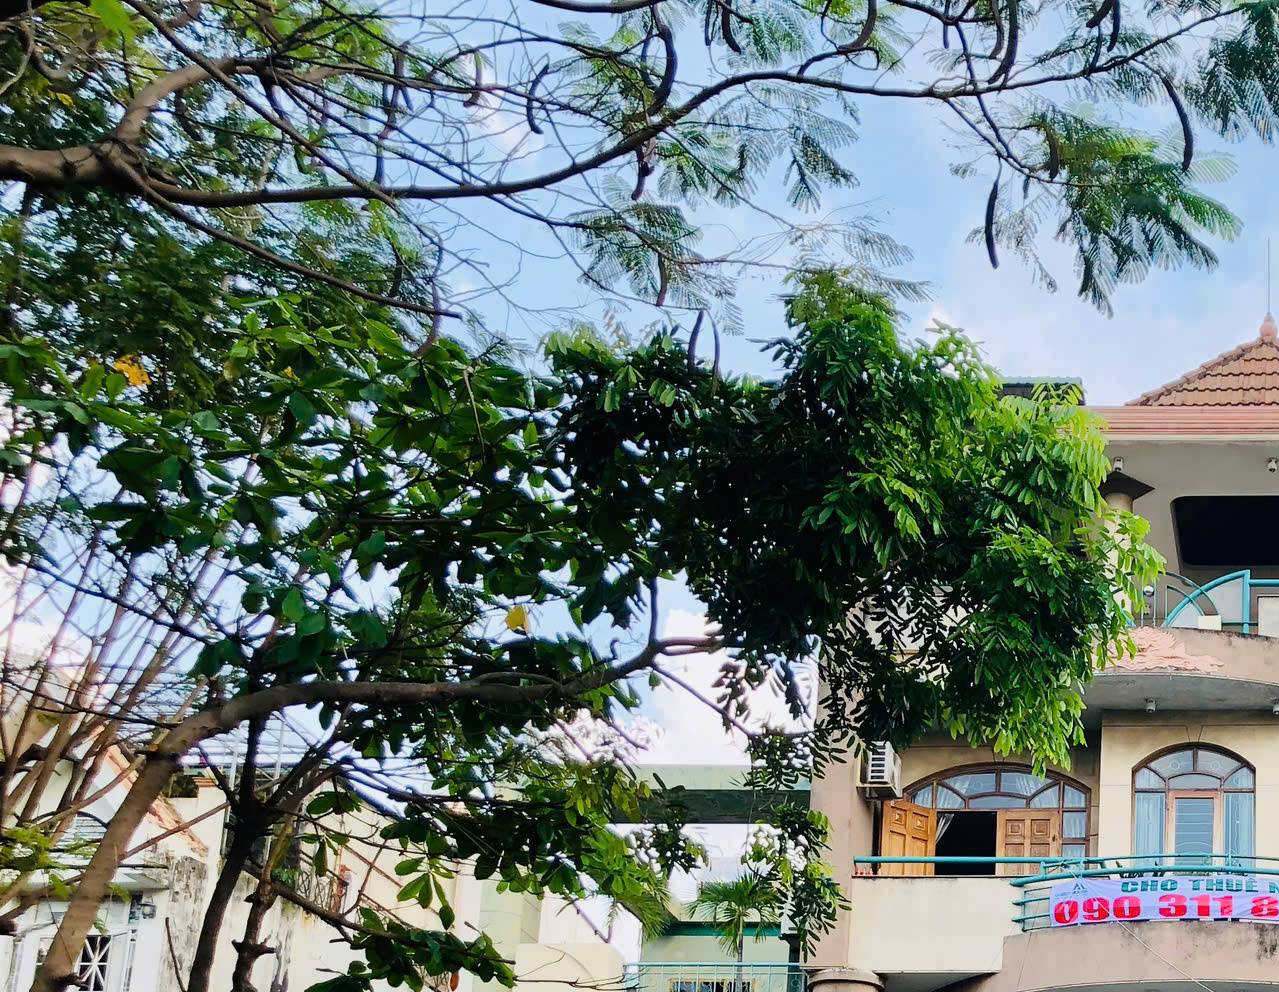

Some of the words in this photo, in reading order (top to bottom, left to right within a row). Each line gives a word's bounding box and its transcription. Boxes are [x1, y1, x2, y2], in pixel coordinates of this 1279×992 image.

[1121, 878, 1178, 893] CHO
[1054, 895, 1141, 924] 090
[1158, 894, 1233, 917] 311
